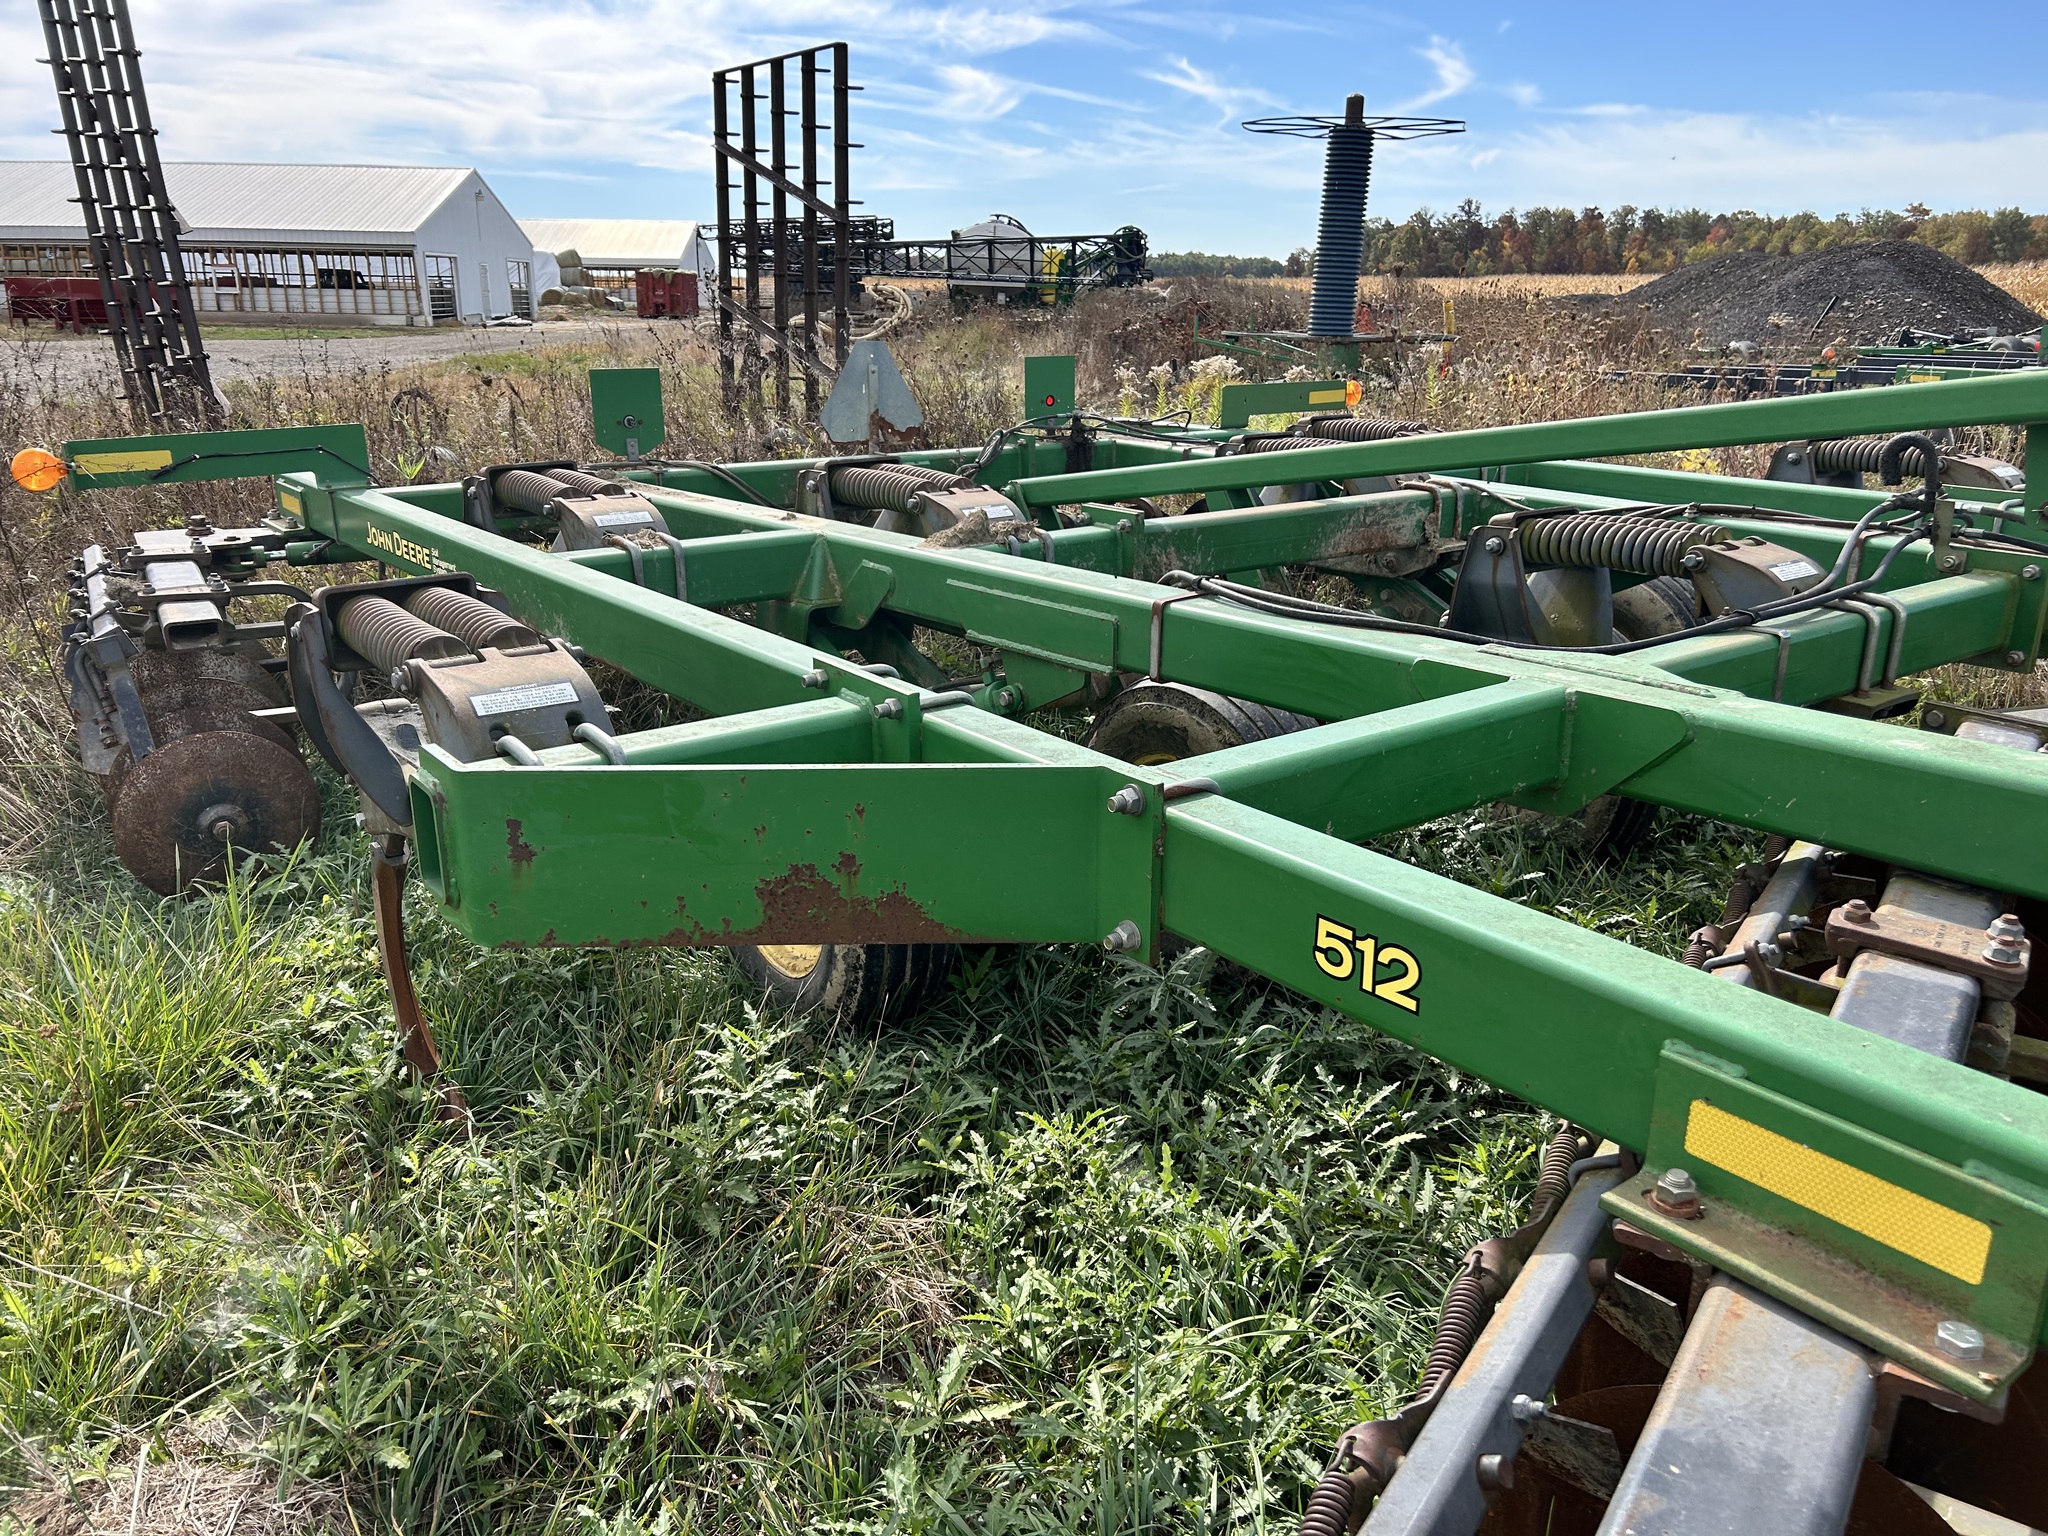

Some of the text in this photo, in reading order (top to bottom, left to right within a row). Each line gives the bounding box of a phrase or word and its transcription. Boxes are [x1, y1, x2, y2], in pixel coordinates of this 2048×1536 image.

[366, 521, 432, 570] JOHN DEERE
[500, 684, 538, 692] IMPORTANT
[1313, 913, 1422, 1017] 512
